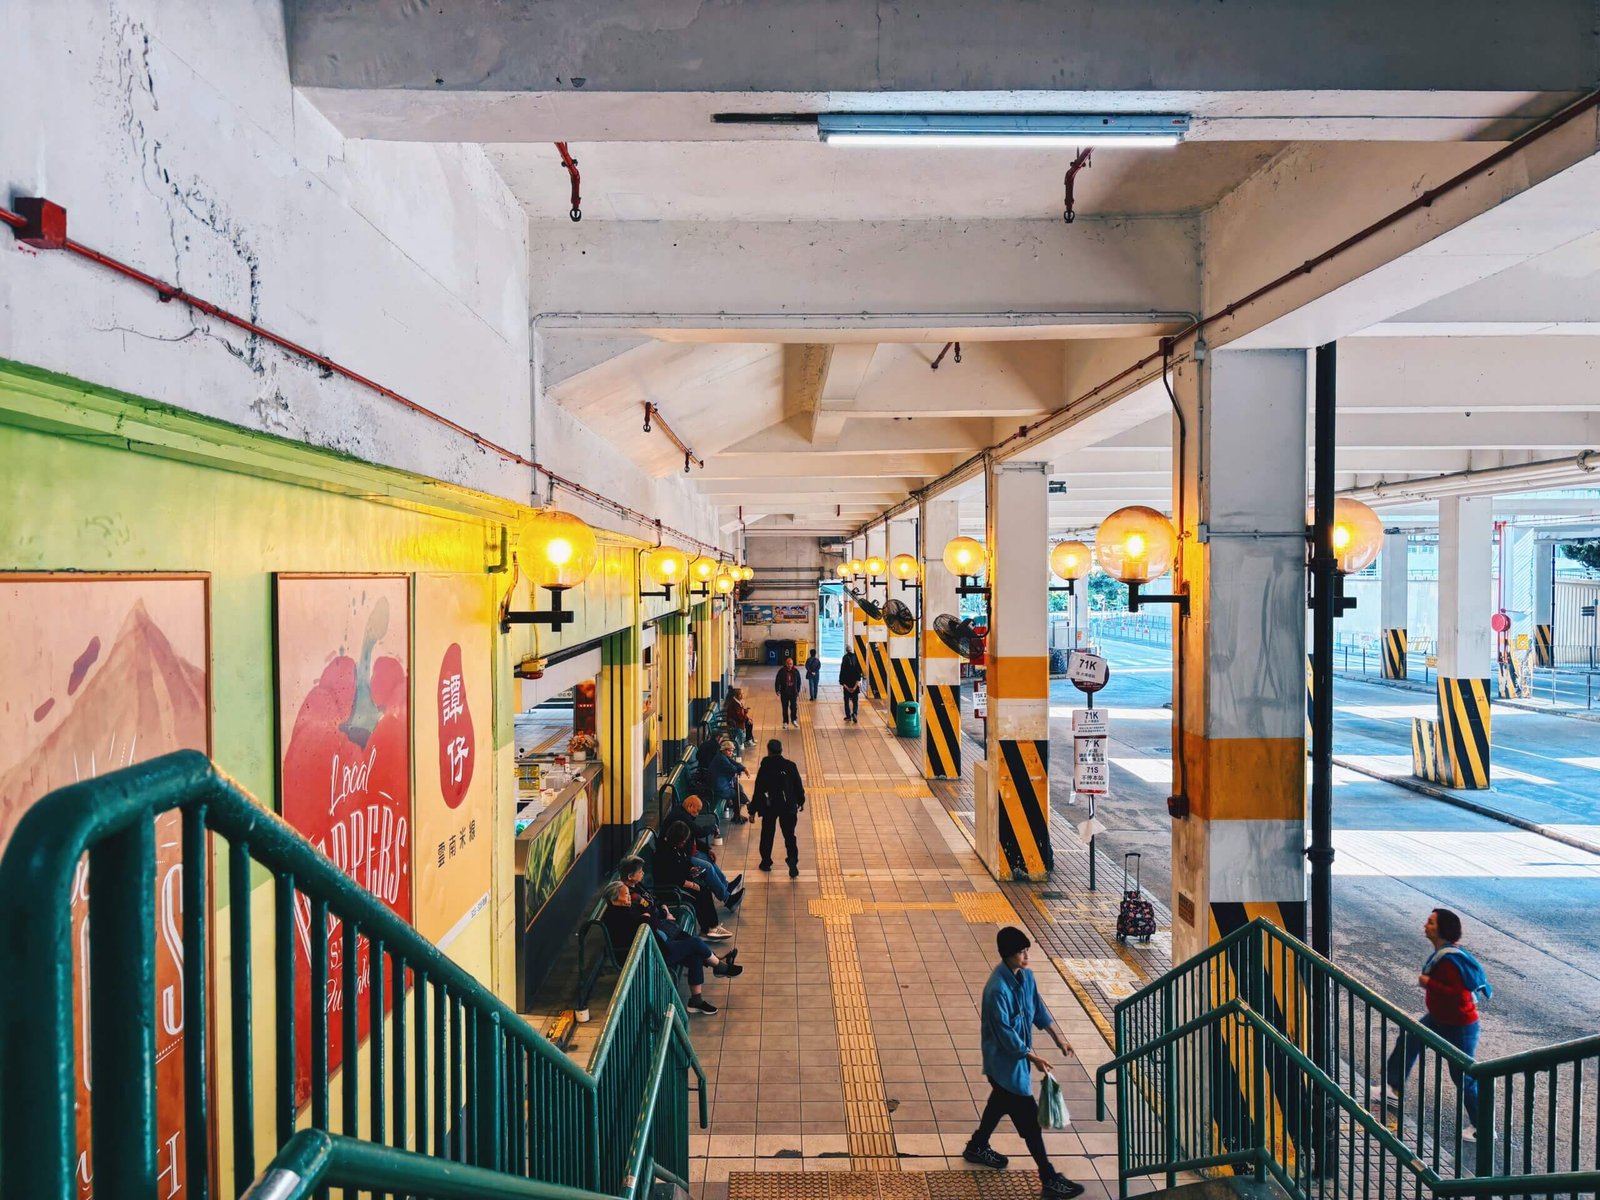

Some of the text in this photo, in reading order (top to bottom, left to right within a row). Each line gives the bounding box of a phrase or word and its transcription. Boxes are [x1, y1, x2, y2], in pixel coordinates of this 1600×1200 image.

[1079, 658, 1098, 671] 71K
[1084, 711, 1099, 719] 71K
[441, 673, 469, 786] 譚仔
[1086, 766, 1099, 774] 71S
[329, 744, 377, 816] Local
